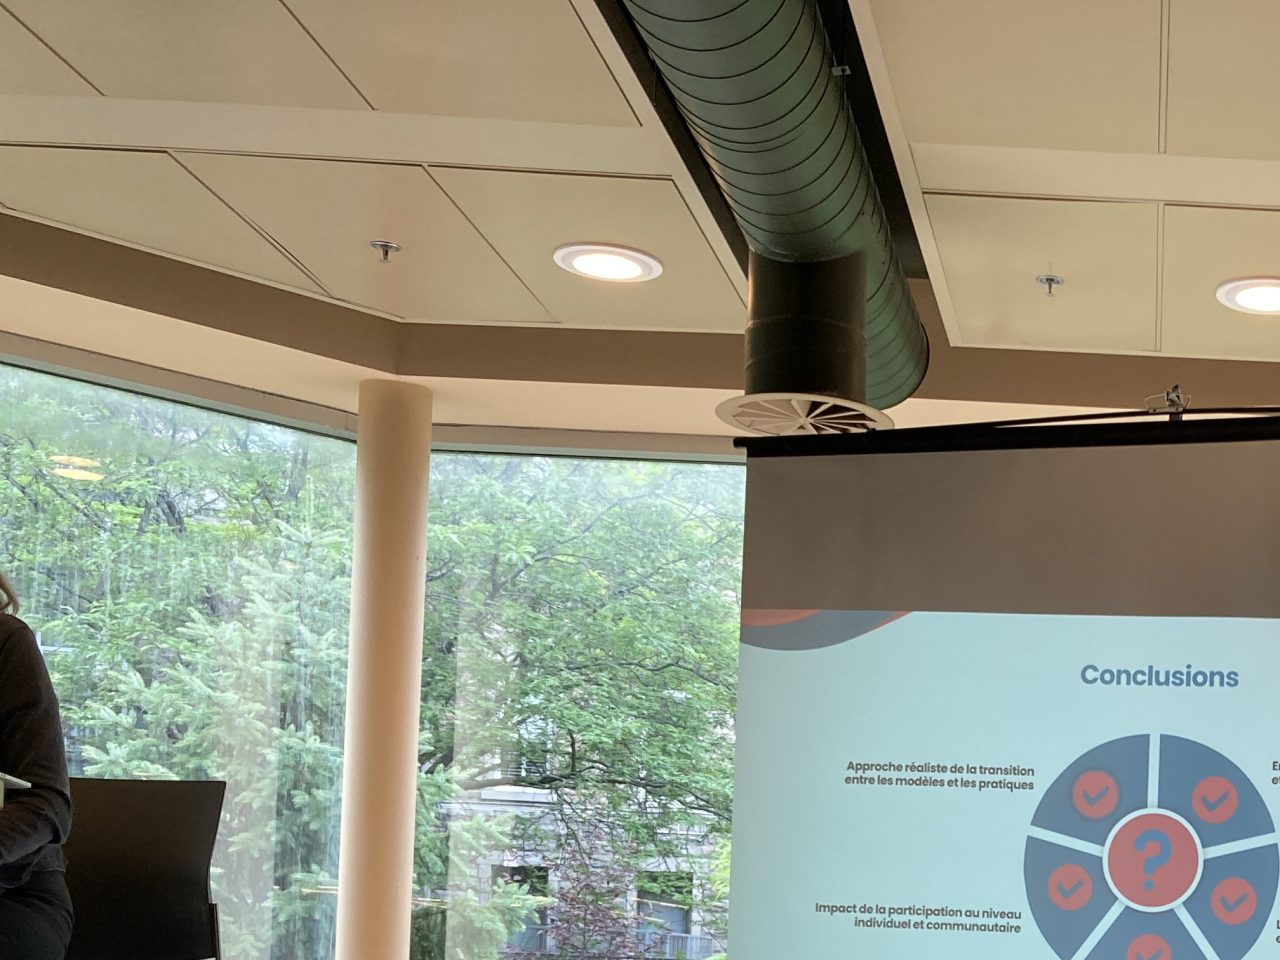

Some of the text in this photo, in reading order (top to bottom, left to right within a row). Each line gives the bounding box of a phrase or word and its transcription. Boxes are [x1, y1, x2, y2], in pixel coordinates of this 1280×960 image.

[1081, 664, 1239, 688] Conclusions
[847, 761, 1035, 776] Approche réaliste de la transition
[845, 775, 1034, 792] entre les modèles et les pratiques
[1134, 829, 1172, 891] ?
[815, 903, 1021, 919] Impact de la participation au niveau
[854, 917, 1021, 933] individuel et communautaire
